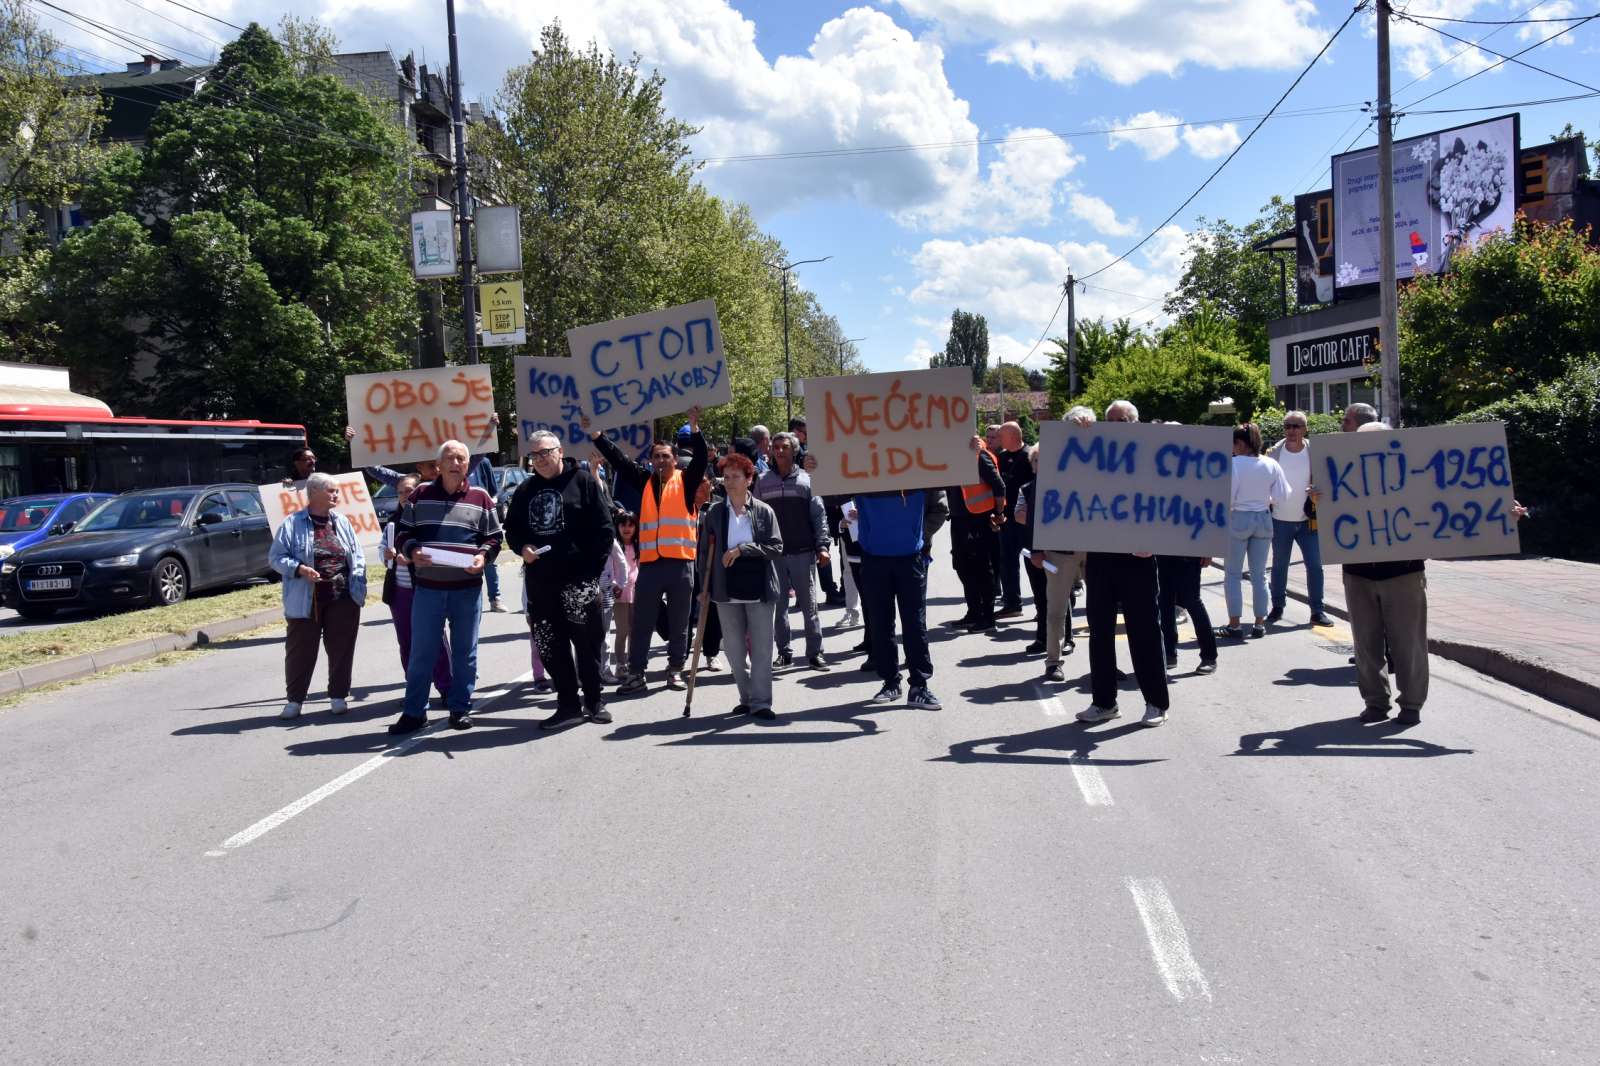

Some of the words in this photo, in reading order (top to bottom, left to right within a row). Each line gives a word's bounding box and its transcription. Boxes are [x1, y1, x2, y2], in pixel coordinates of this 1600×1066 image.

[591, 318, 714, 377] СТОП
[1340, 335, 1370, 362] CAFE
[365, 379, 439, 414] ОВО
[825, 379, 969, 442] NEĆEMO
[363, 412, 493, 453] НАШЕ
[1057, 436, 1137, 474] МИ
[1155, 442, 1228, 479] СМО
[1041, 489, 1226, 540] ВЛАСНИЦИ
